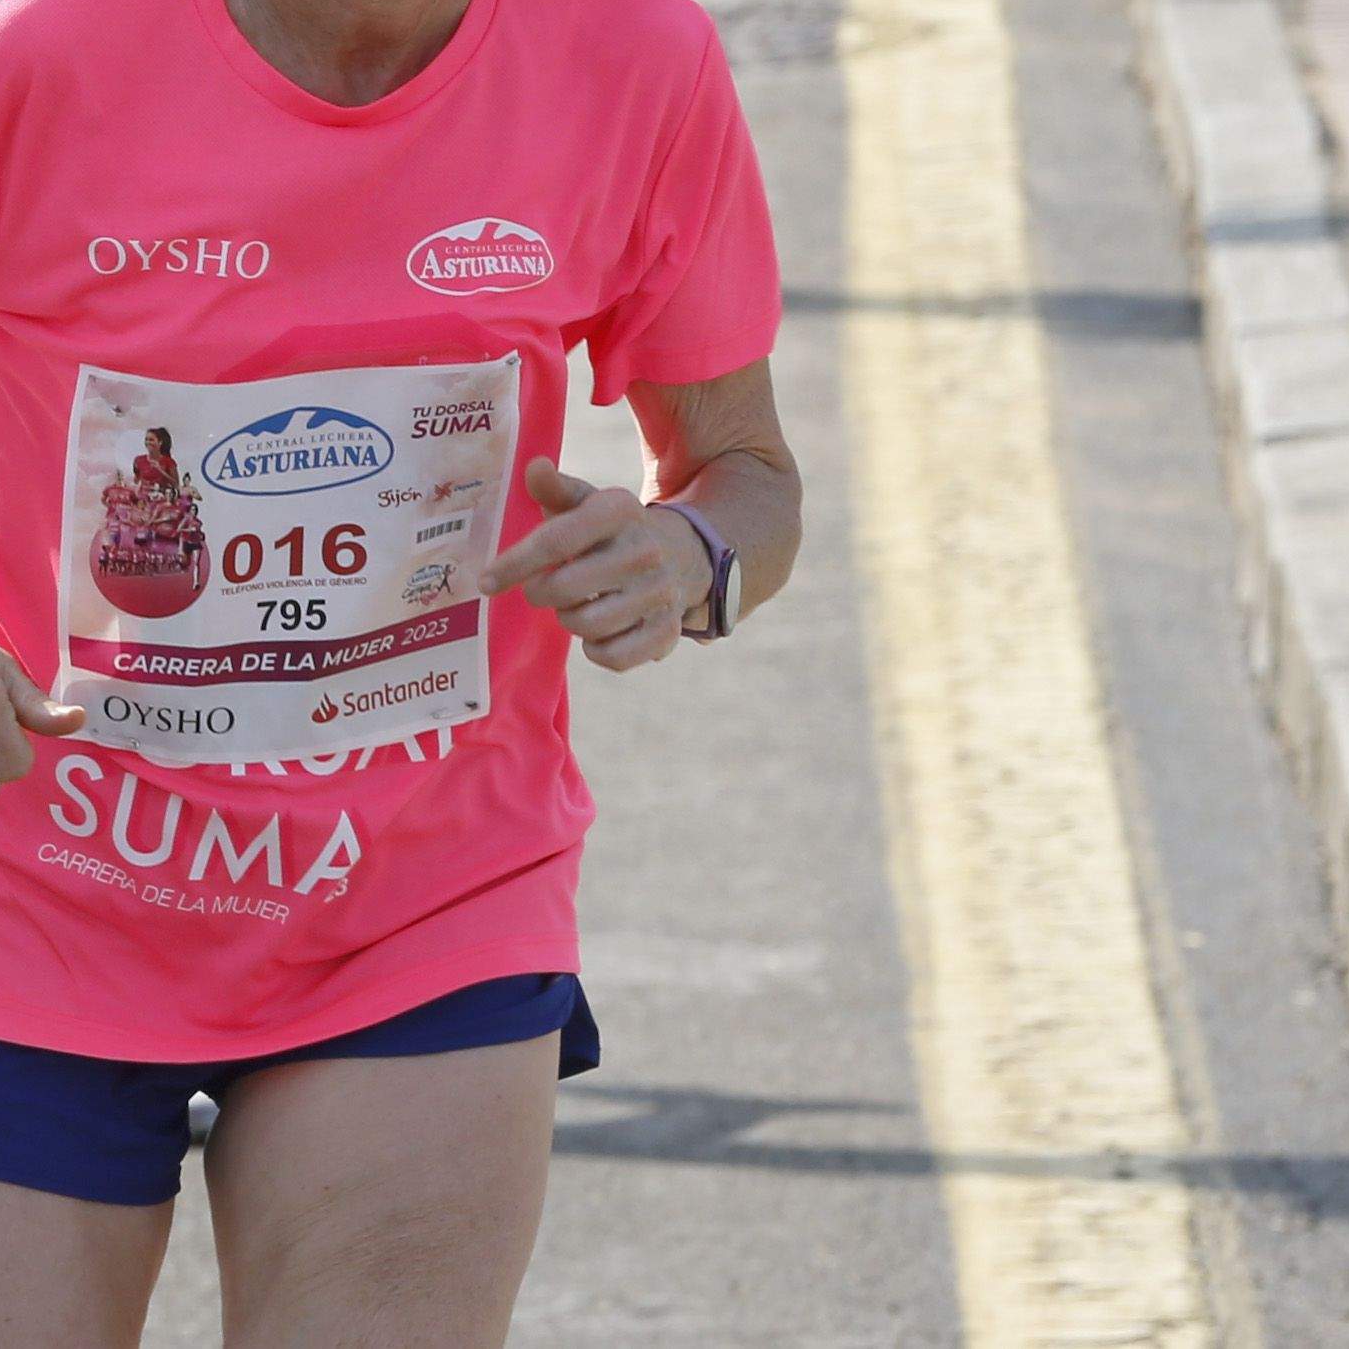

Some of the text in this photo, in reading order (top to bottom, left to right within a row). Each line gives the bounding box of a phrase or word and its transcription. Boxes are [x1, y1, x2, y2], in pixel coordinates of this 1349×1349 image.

[88, 236, 270, 280] OYSHO
[419, 248, 547, 279] ASTURIANA
[411, 414, 492, 439] SUMA
[412, 400, 495, 418] TU DORSAL
[246, 432, 374, 451] CENTRAL LECHERA
[216, 445, 379, 480] ASTURIANA
[222, 523, 367, 584] 016
[221, 582, 264, 596] TELÉFONO
[266, 579, 313, 589] VIOLENCIA
[315, 578, 327, 587] DE
[257, 599, 327, 631] 795
[113, 618, 449, 677] CARRERA DE LA MUJER 2023
[342, 669, 459, 717] Santander
[103, 695, 236, 735] OYSHO
[49, 754, 362, 895] SUMA
[37, 843, 290, 925] CARRERA DE LA MUJER
